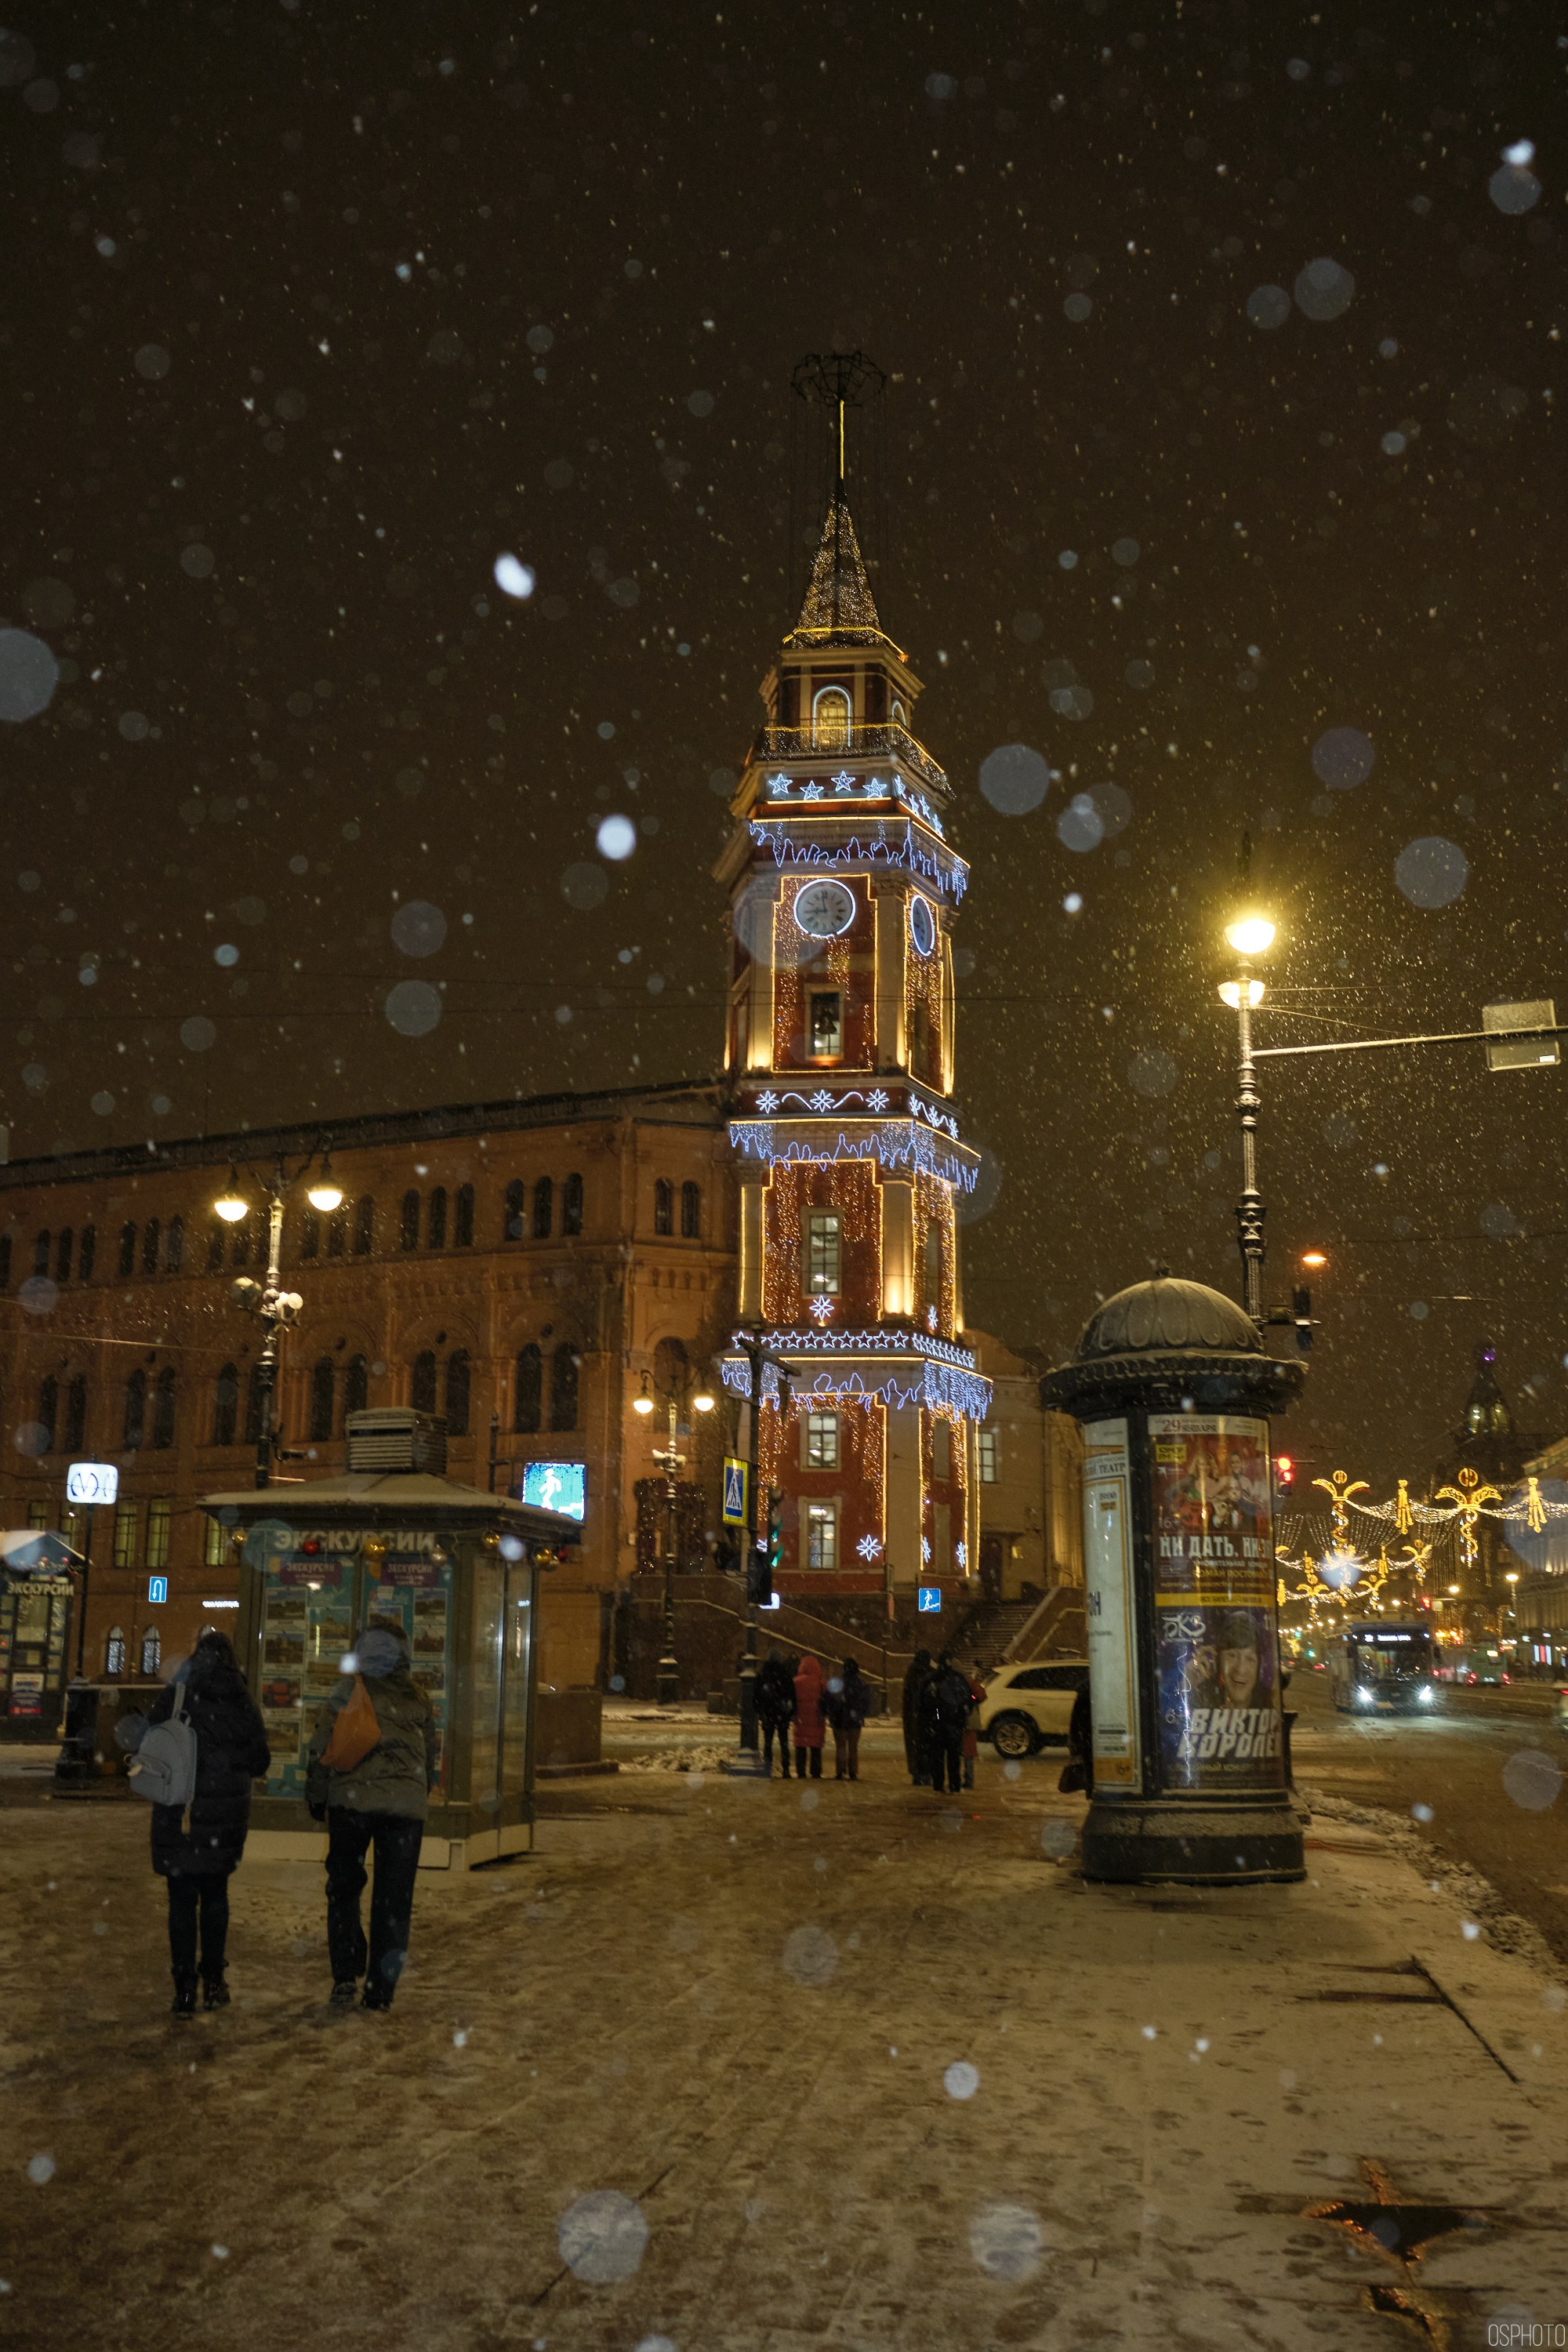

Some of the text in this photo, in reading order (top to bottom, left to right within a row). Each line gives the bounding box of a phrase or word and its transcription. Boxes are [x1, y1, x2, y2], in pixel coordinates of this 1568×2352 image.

[1159, 1536, 1184, 1558] НИ
[286, 1562, 335, 1573] ЭКСКУРСИИ
[386, 1563, 434, 1574] ЭКСКУРСИИ
[7, 1581, 74, 1596] ЭКСКУРСИИ
[1190, 1708, 1279, 1733] ВИКТОР
